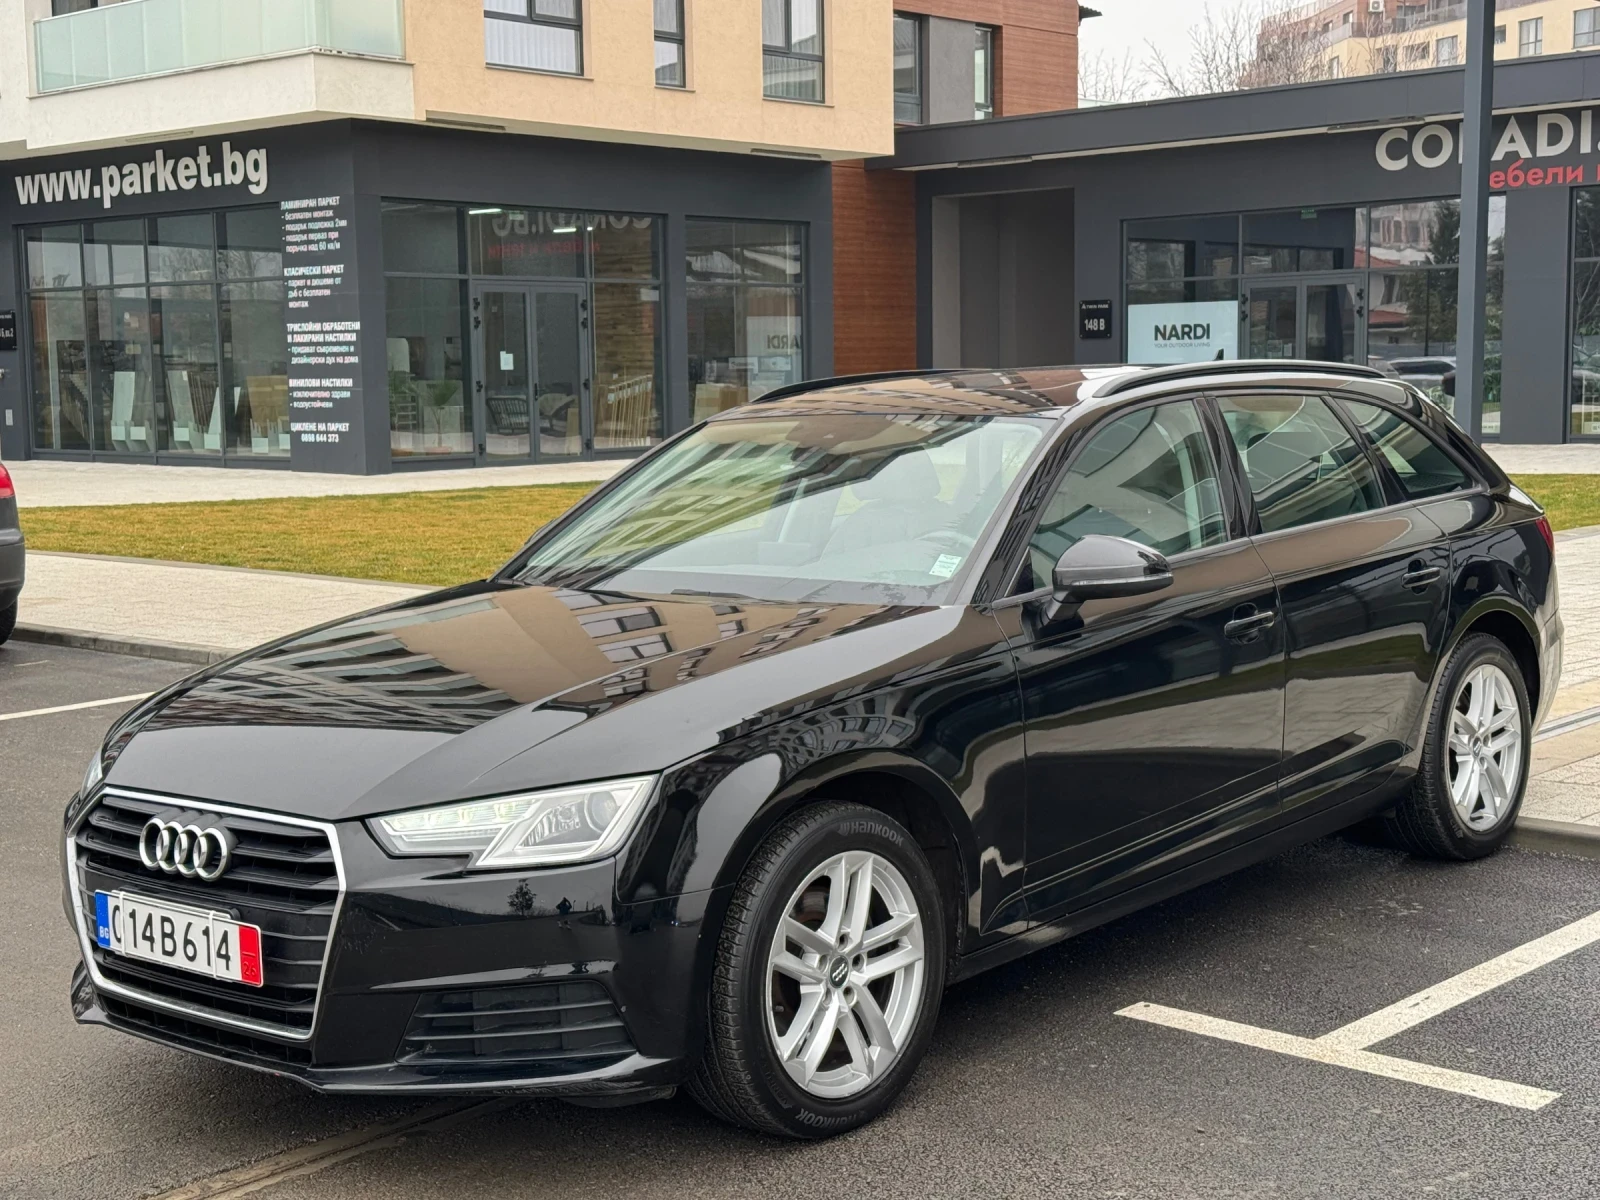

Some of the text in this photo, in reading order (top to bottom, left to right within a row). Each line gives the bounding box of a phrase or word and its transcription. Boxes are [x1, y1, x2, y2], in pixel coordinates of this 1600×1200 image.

[1375, 110, 1600, 171] COADI
[15, 141, 268, 209] www.parket.bg
[1489, 158, 1584, 189] ебели
[281, 196, 340, 210] ЛАМИНИРАН ПАРКЕТ
[285, 210, 333, 220] безплатен монтаж
[328, 231, 339, 240] при
[286, 244, 307, 253] поръчка
[319, 242, 326, 250] 60
[284, 264, 344, 276] КЛАСИЧЕСКИ ПАРКЕТ
[288, 289, 297, 298] дъб
[303, 289, 330, 297] безплатен
[287, 321, 360, 332] ТРИСЛОЙНИ ОБРАБОТЕНИ
[1085, 318, 1098, 330] 148
[1154, 323, 1210, 341] NARDI
[287, 333, 356, 343] И ЛАКИРАНИ НАСТИЛКИ
[326, 356, 335, 365] дух
[289, 378, 352, 387] ВИНИЛОВИ НАСТИЛКИ
[291, 423, 349, 432] ЦИКЛЕНЕ НА ПАРКЕТ
[316, 434, 326, 442] 644
[328, 434, 339, 442] 373
[99, 925, 109, 939] BG
[243, 961, 257, 977] 26
